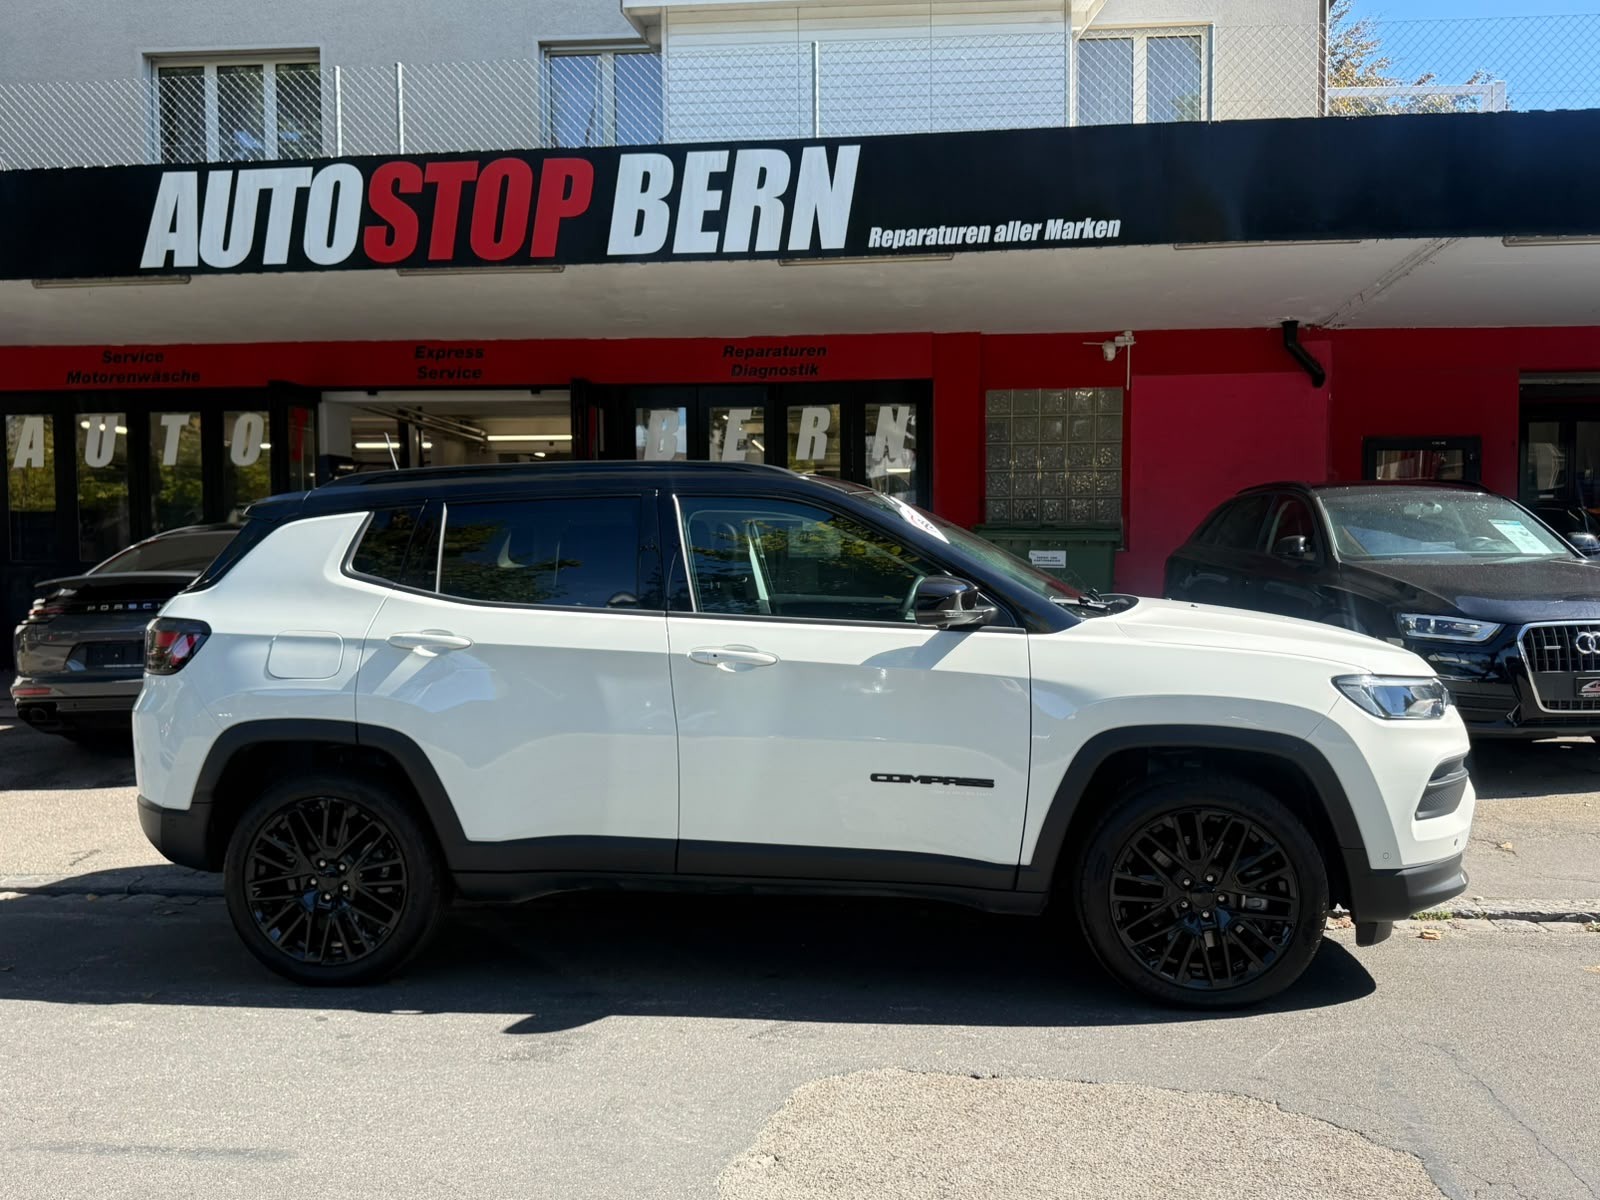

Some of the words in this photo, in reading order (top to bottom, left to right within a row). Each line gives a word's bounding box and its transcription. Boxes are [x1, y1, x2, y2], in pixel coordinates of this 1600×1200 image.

[606, 144, 862, 256] BERN
[868, 225, 991, 249] Reparaturen
[993, 221, 1043, 244] aller
[1044, 217, 1122, 241] Marken
[102, 350, 165, 364] Service
[415, 345, 485, 361] Express
[722, 344, 827, 360] Reparaturen
[416, 365, 483, 380] Service
[731, 362, 819, 379] Diagnostik
